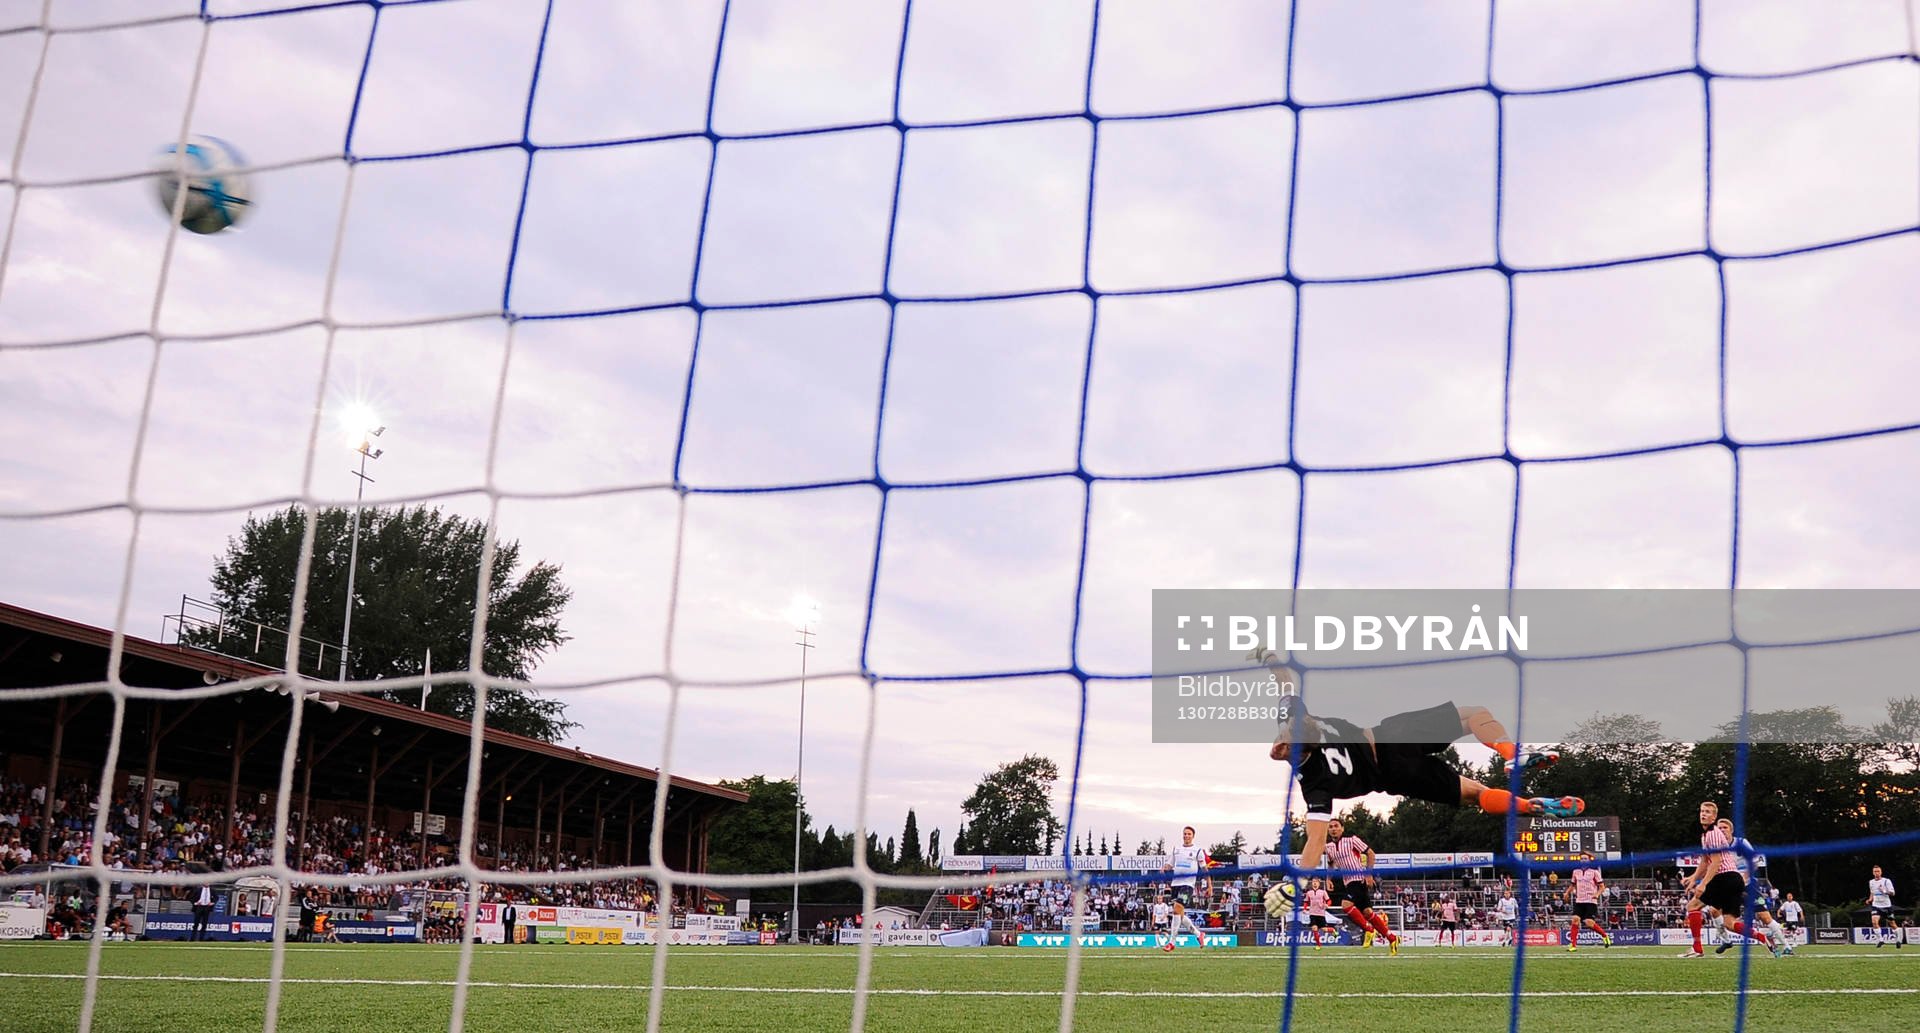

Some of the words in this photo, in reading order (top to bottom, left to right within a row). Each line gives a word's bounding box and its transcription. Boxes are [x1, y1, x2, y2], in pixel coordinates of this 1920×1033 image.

[1543, 819, 1598, 828] Klockmaster
[1546, 833, 1553, 841] A
[1572, 833, 1578, 841] C
[1597, 833, 1603, 841] E
[1547, 843, 1553, 851] B
[1572, 843, 1578, 851] D
[1598, 843, 1603, 851] F
[1032, 857, 1103, 869] Arbetabladet.
[888, 932, 923, 942] gavle.se
[1033, 936, 1065, 946] YIT
[1077, 936, 1106, 946] YIT
[1117, 936, 1146, 946] YIT
